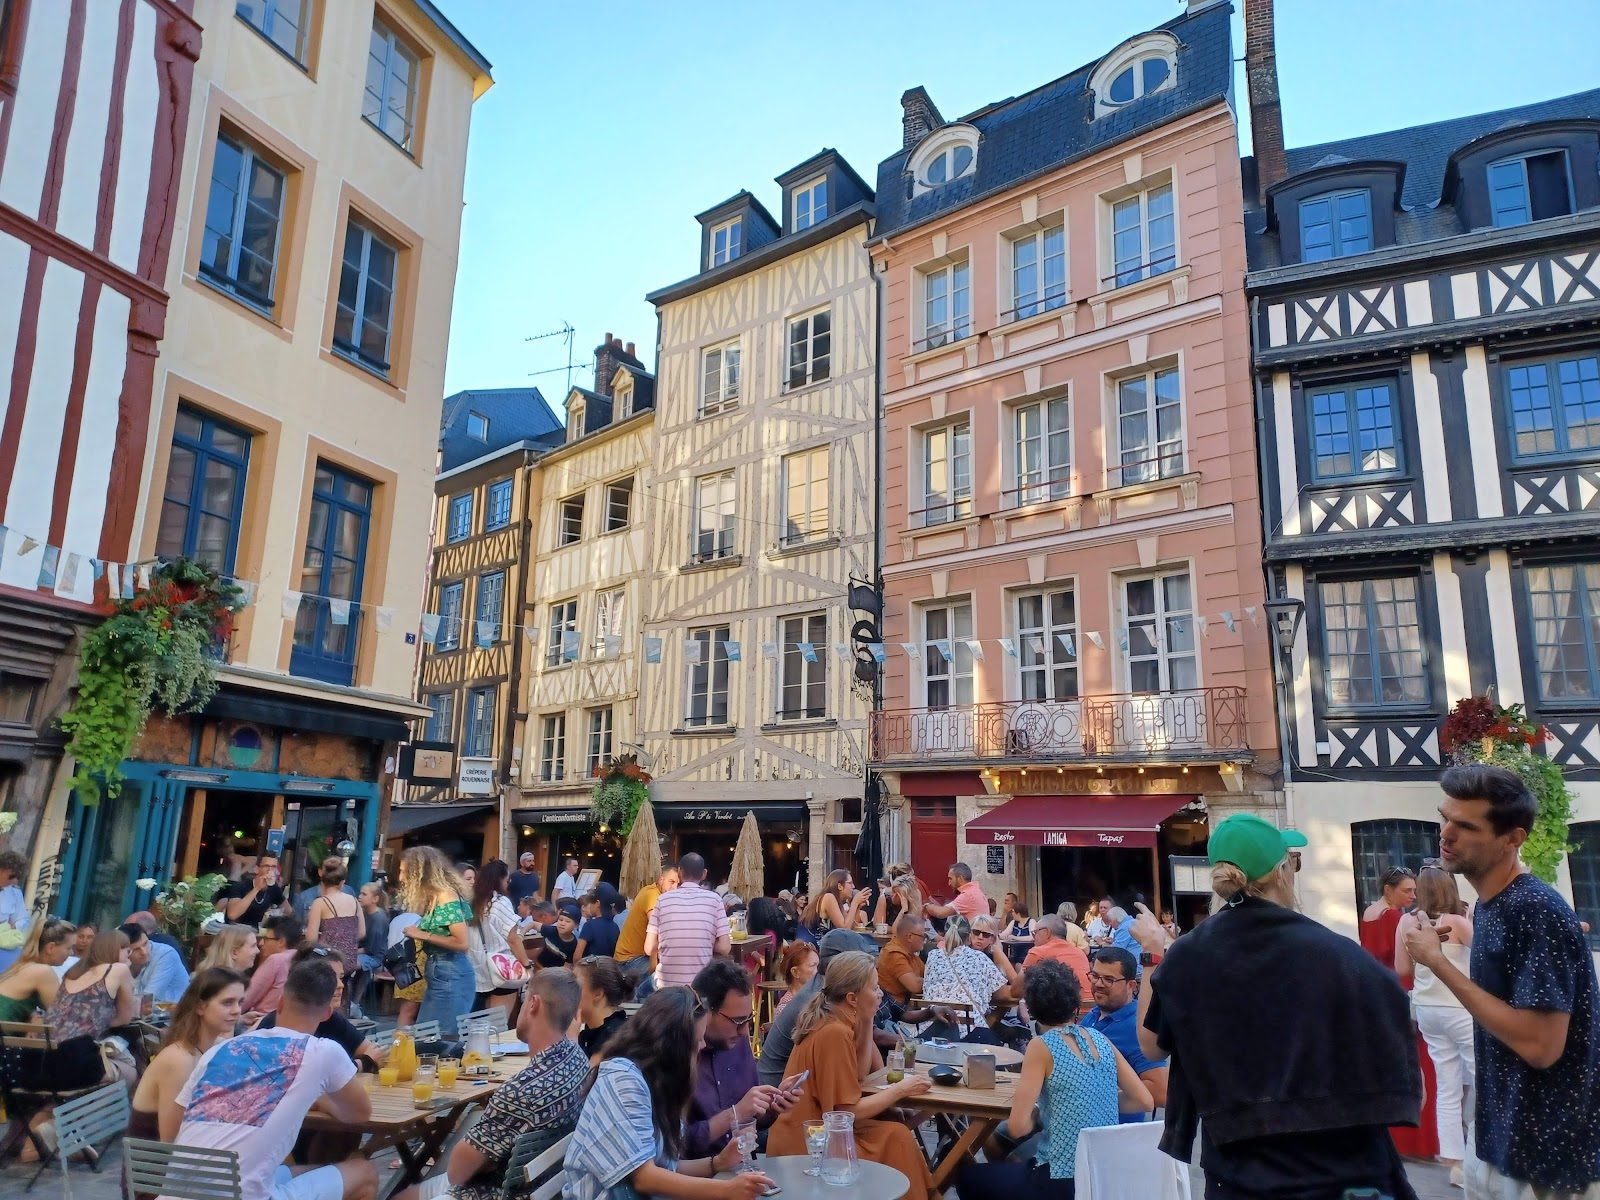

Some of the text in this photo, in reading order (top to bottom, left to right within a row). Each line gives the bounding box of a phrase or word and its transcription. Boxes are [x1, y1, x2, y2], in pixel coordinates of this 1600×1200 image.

[684, 810, 695, 820] Au
[993, 831, 1015, 842] Resto
[1097, 833, 1125, 845] Tapas
